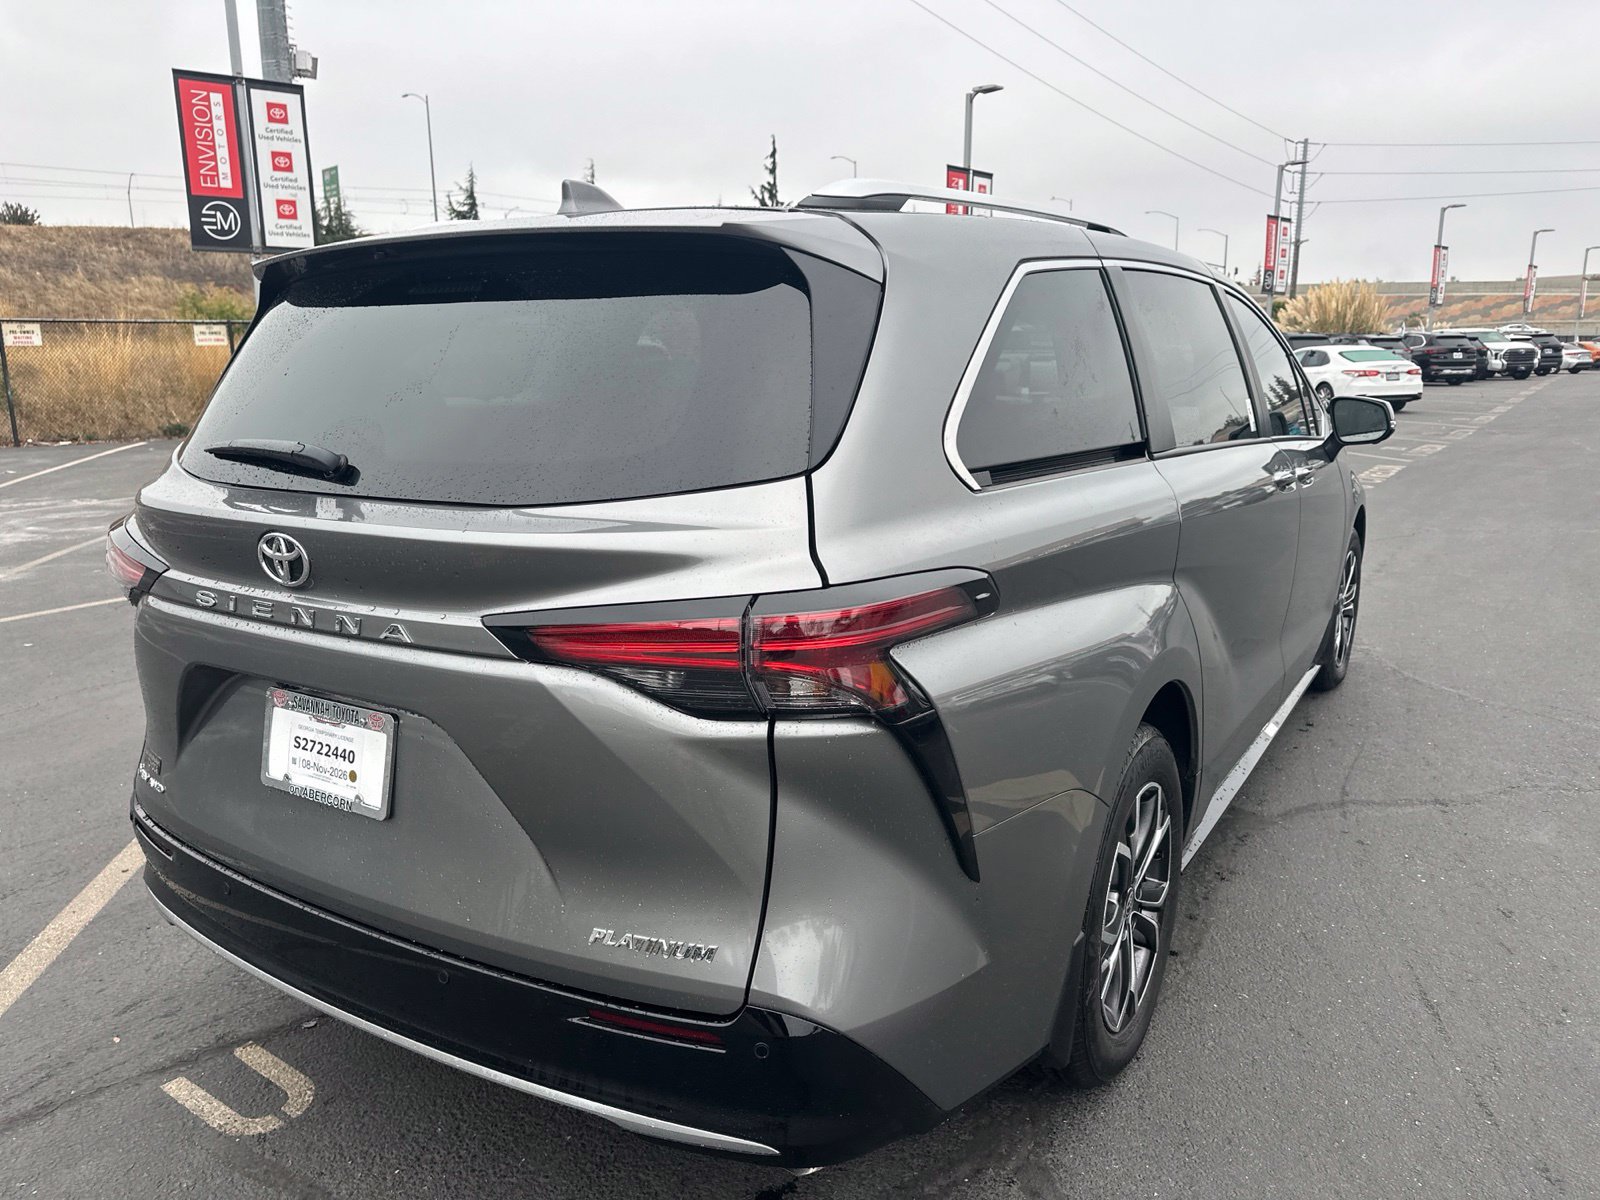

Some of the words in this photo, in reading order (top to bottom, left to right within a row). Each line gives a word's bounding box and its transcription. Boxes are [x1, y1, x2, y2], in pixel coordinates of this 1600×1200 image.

[190, 89, 218, 188] ENVISION
[213, 101, 229, 181] MOTORS
[265, 127, 293, 136] Certified
[276, 135, 302, 144] Vehicles
[263, 182, 281, 190] Used
[281, 183, 306, 192] Vehicles
[270, 175, 298, 184] Certified
[275, 223, 303, 231] Certified
[285, 230, 310, 239] Vehicles
[195, 589, 415, 644] SIENNA
[293, 695, 330, 716] SAVANNAH
[332, 704, 360, 724] TOYOTA
[293, 735, 356, 765] S2722440
[301, 758, 348, 781] 08-Nov-2026
[301, 787, 353, 812] ABERCORN
[587, 927, 719, 963] PLATINUM
